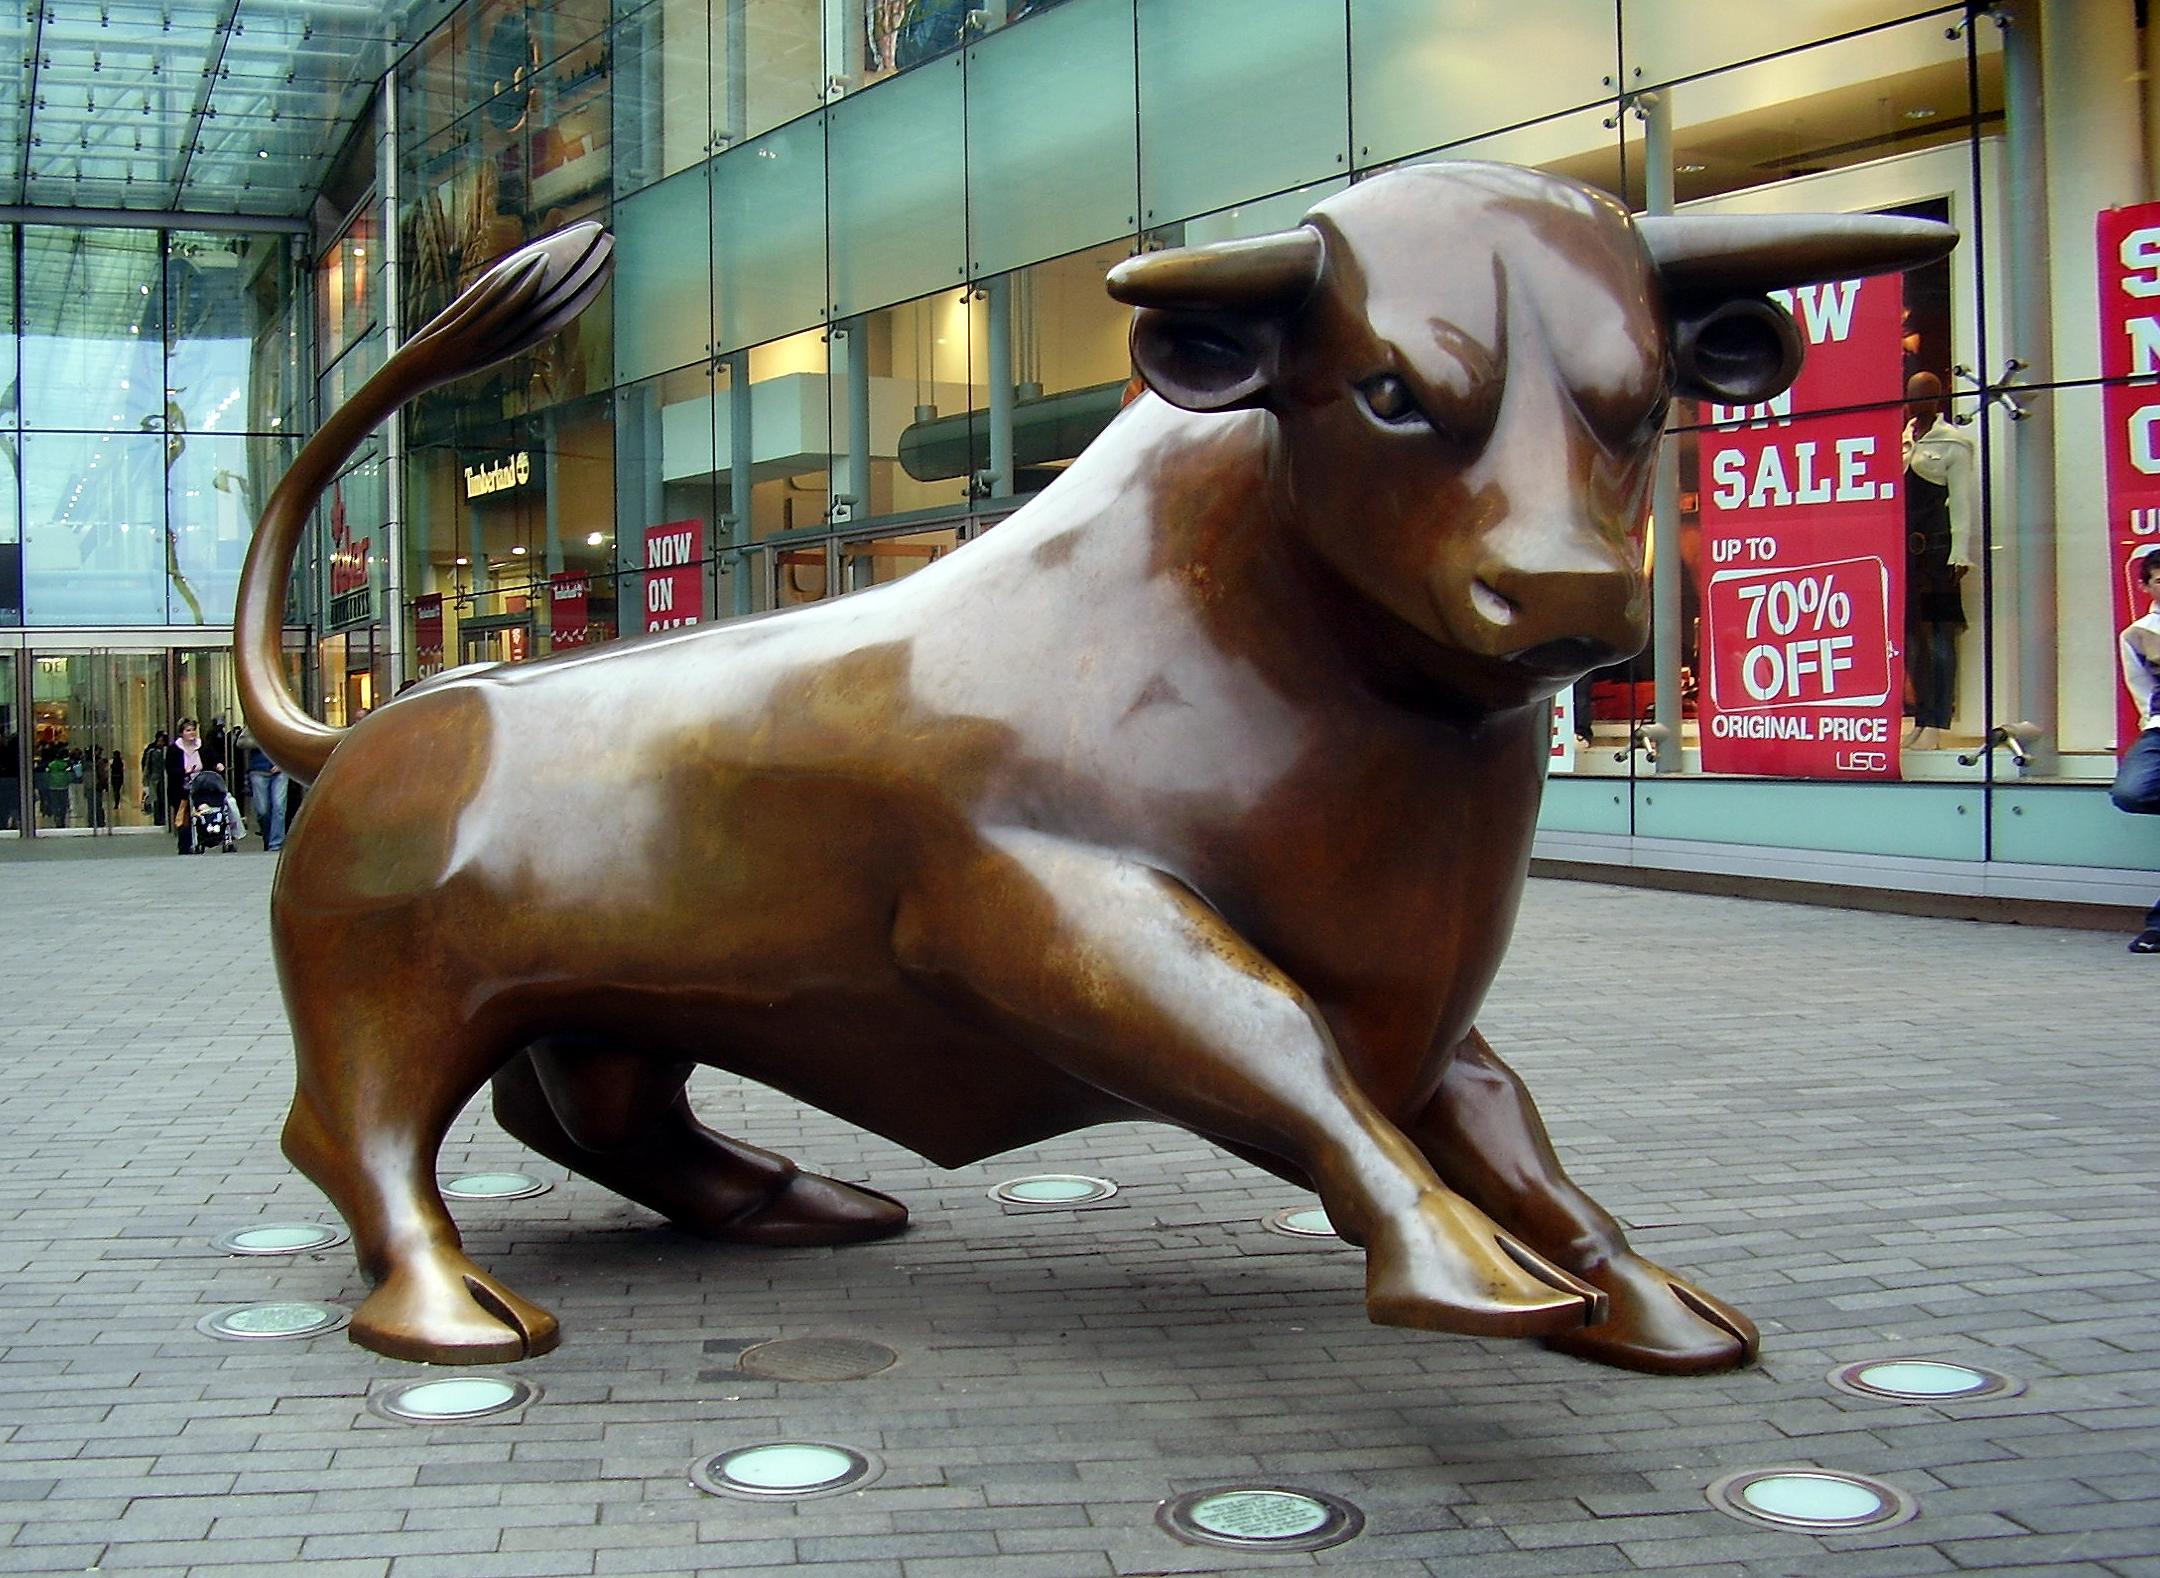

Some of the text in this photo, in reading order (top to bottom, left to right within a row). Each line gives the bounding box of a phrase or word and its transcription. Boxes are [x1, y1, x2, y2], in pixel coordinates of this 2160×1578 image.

[1713, 437, 1894, 510] SALE.
[648, 532, 692, 569] NOW
[1712, 537, 1777, 562] UP TO
[648, 577, 673, 612] ON
[1738, 574, 1851, 639] 70%
[1742, 635, 1853, 700] OFF
[1712, 715, 1888, 742] ORIGINAL PRICE
[1836, 751, 1887, 771] USC
